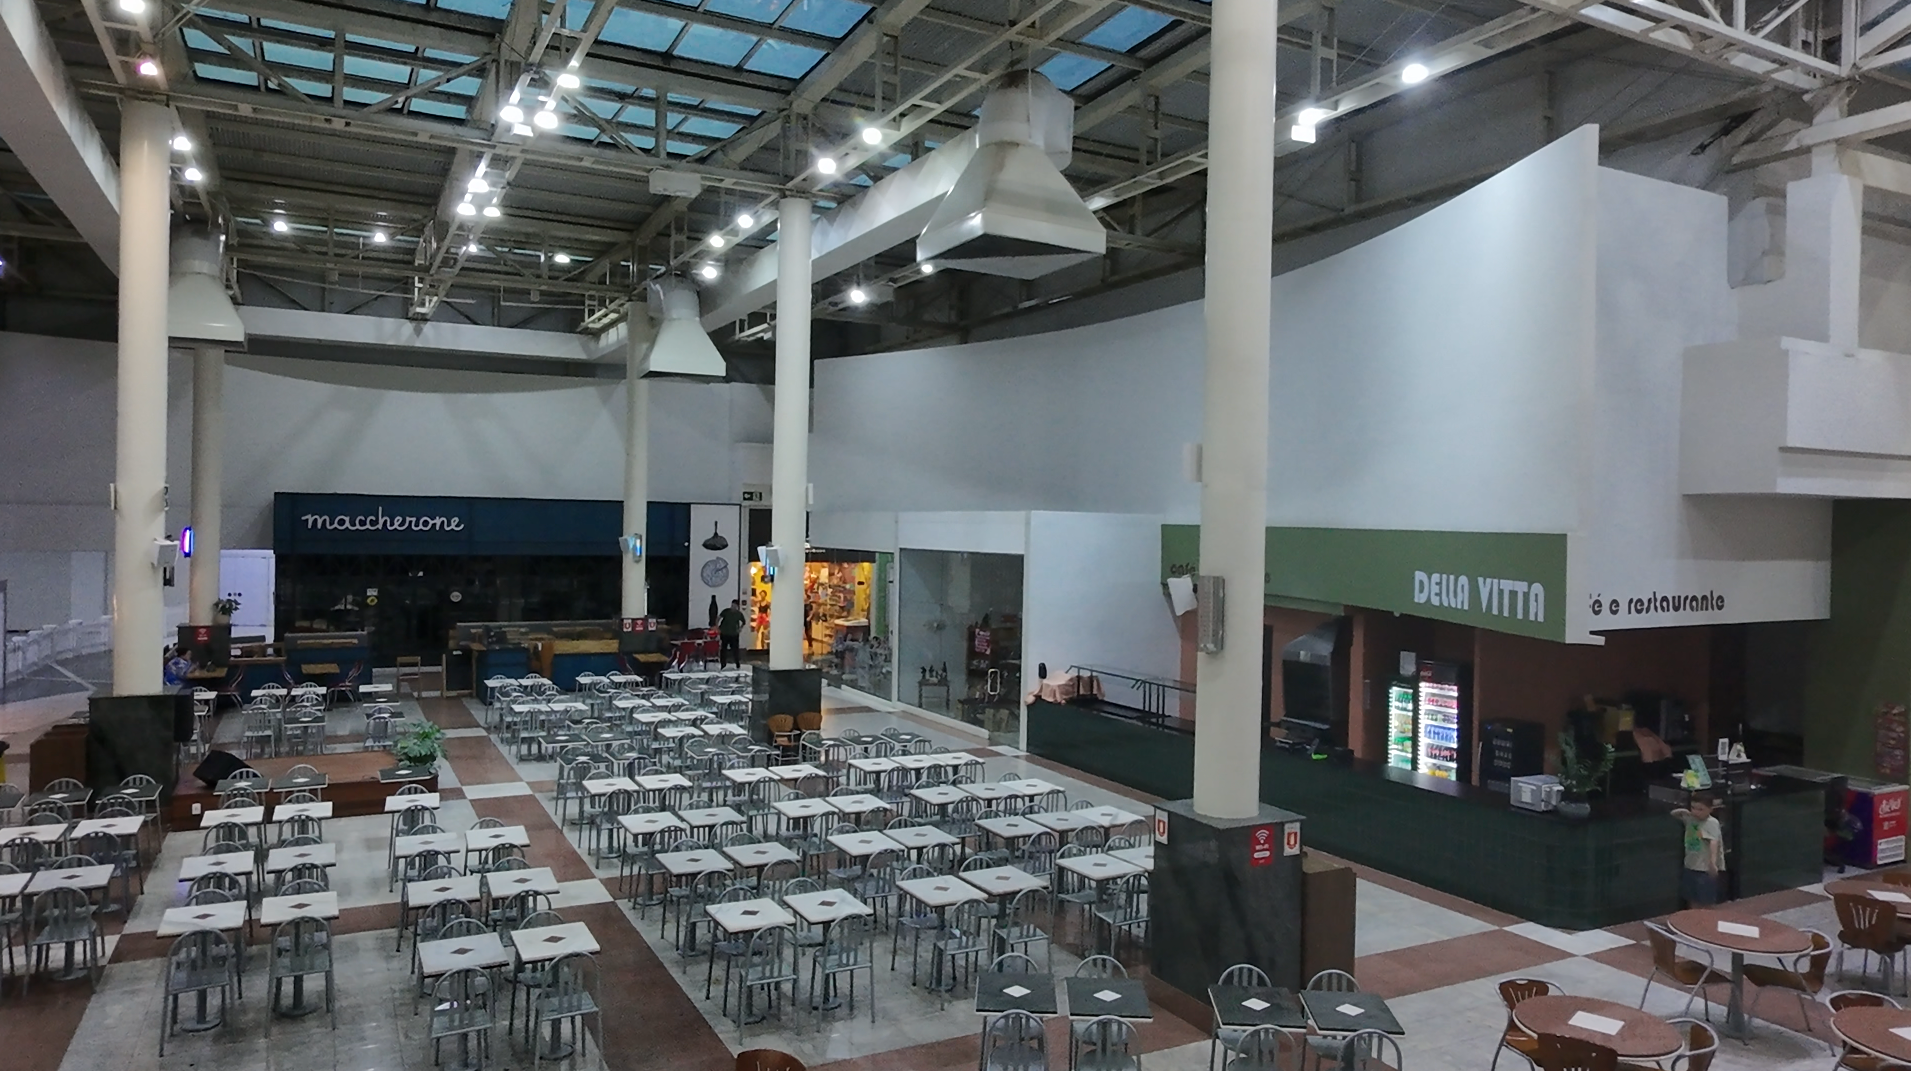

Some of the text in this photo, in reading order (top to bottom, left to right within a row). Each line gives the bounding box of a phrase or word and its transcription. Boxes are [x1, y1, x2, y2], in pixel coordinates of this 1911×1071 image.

[301, 506, 464, 531] maccherone
[1414, 570, 1545, 622] DELLA VITTA
[1609, 598, 1620, 616] e
[1628, 590, 1725, 615] restaurante
